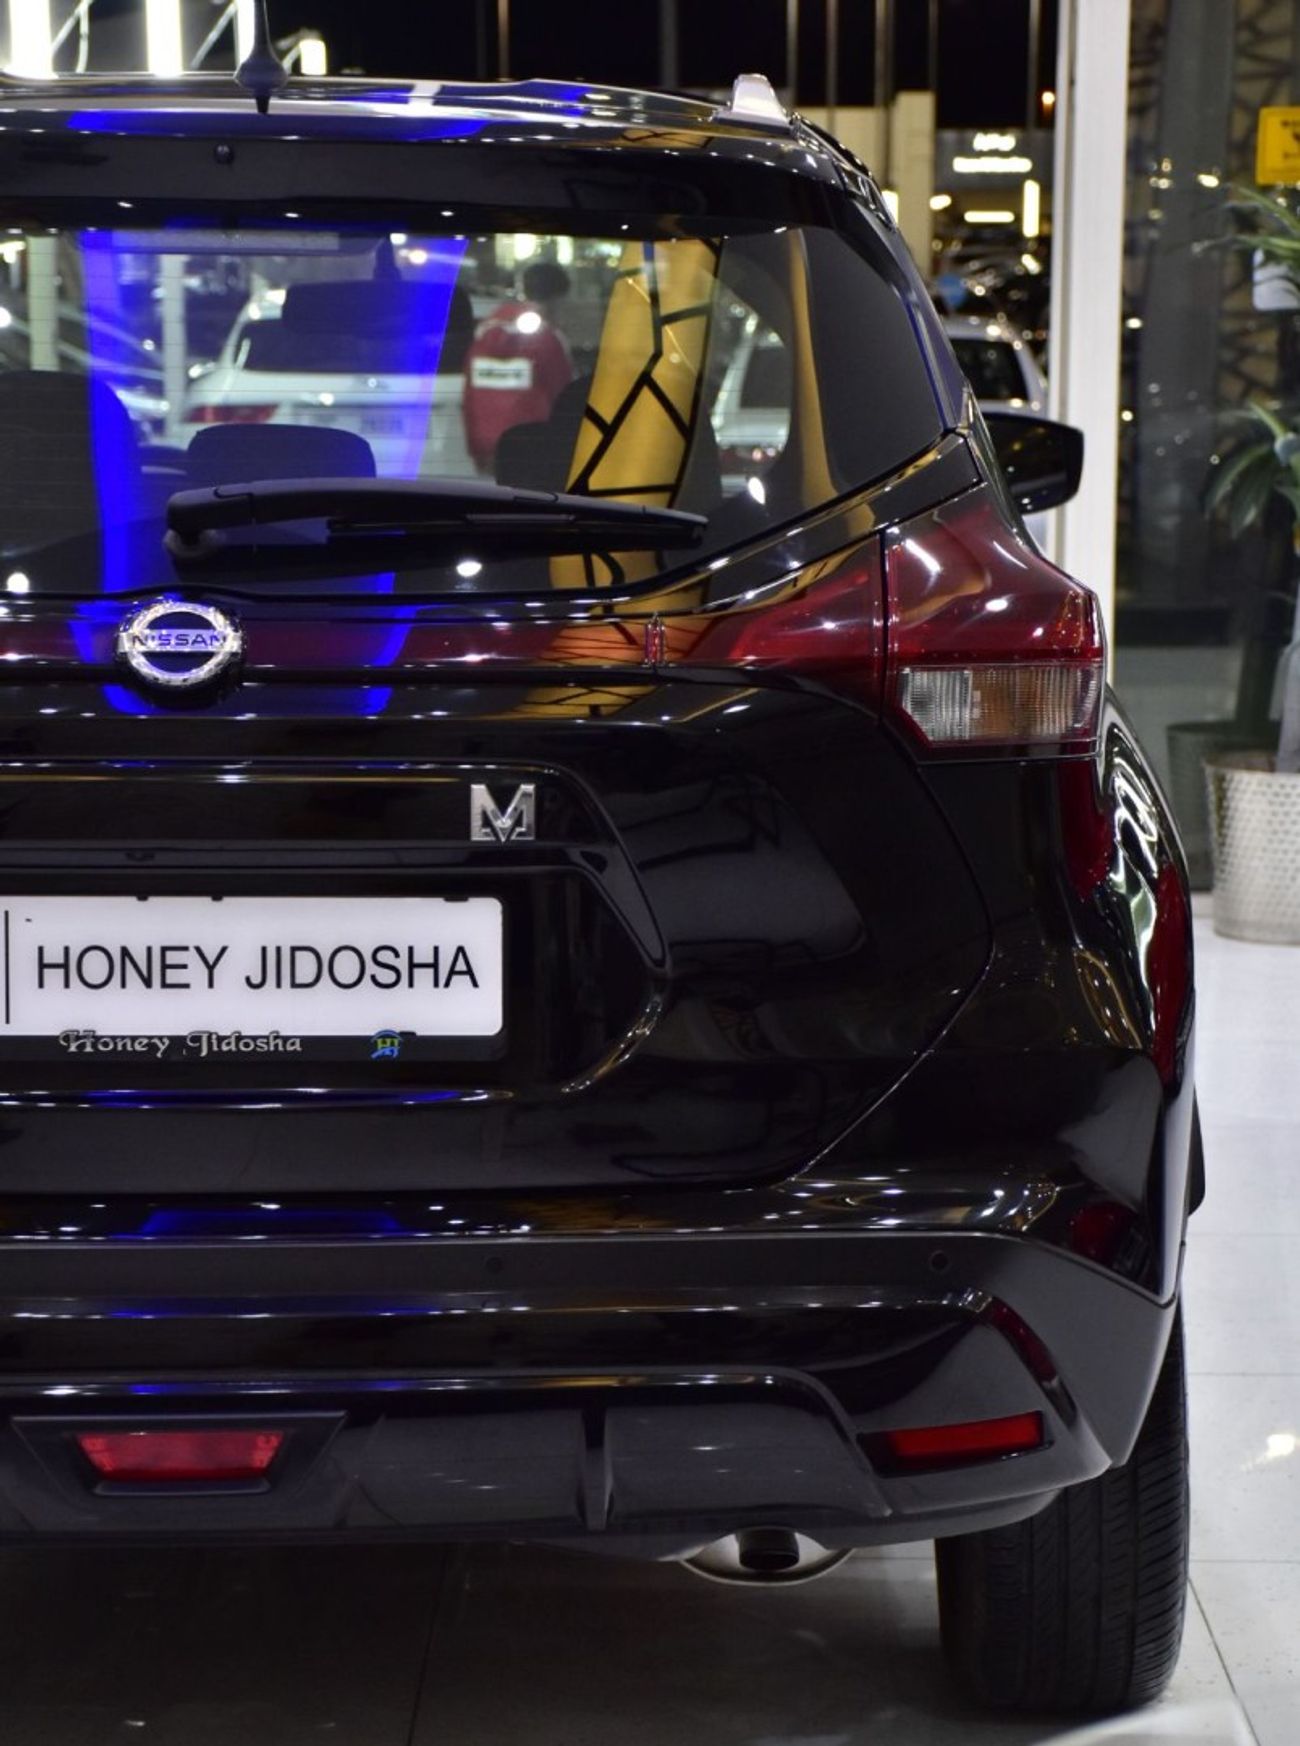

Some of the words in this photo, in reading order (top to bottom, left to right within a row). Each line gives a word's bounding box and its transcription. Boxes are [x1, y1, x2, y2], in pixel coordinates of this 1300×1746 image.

[132, 633, 226, 646] NISSAN
[37, 945, 229, 990] HONEY
[245, 945, 480, 990] JIDOSHA
[59, 1029, 170, 1057] Honey
[187, 1030, 302, 1056] Jidosha
